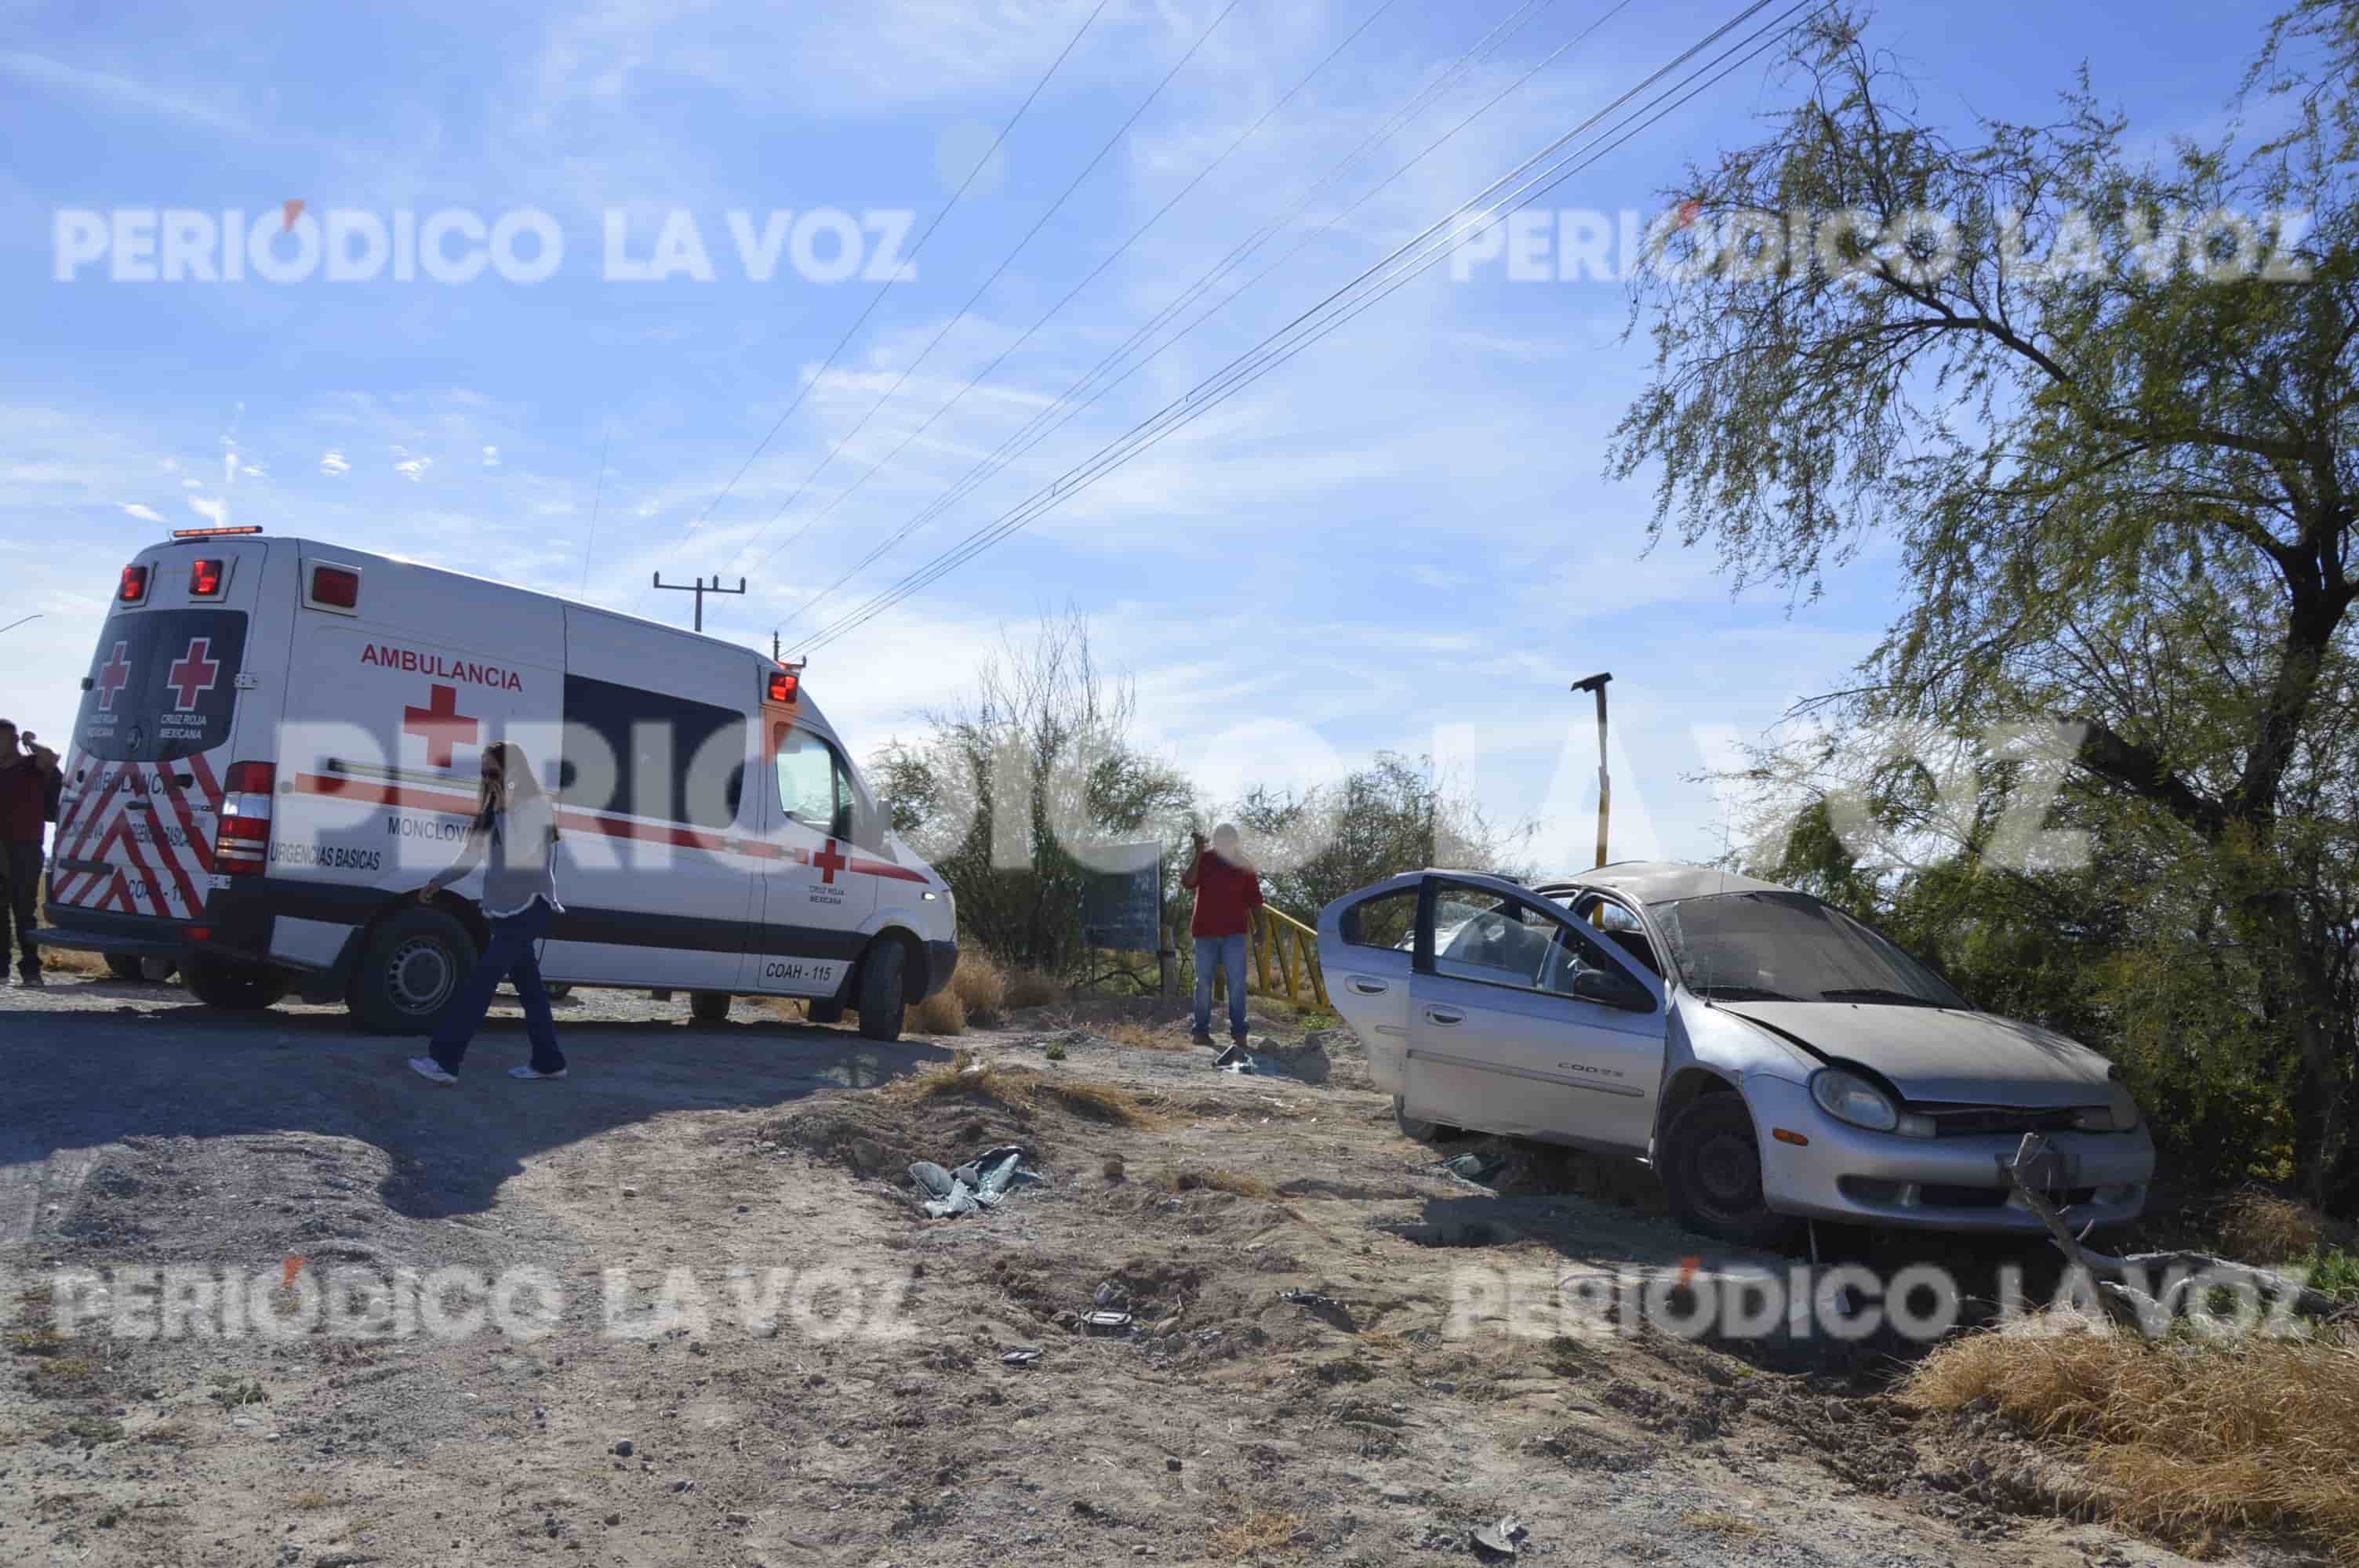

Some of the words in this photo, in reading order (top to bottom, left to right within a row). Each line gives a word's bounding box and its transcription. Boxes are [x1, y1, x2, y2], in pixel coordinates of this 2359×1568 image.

[361, 643, 523, 692] AMBULANCIA
[183, 715, 206, 727] ROJA
[387, 816, 472, 843] MONCLOV
[270, 840, 333, 866] URGENCIAS
[336, 847, 382, 871] BASICAS
[765, 962, 803, 979] COAH
[812, 966, 833, 980] 115
